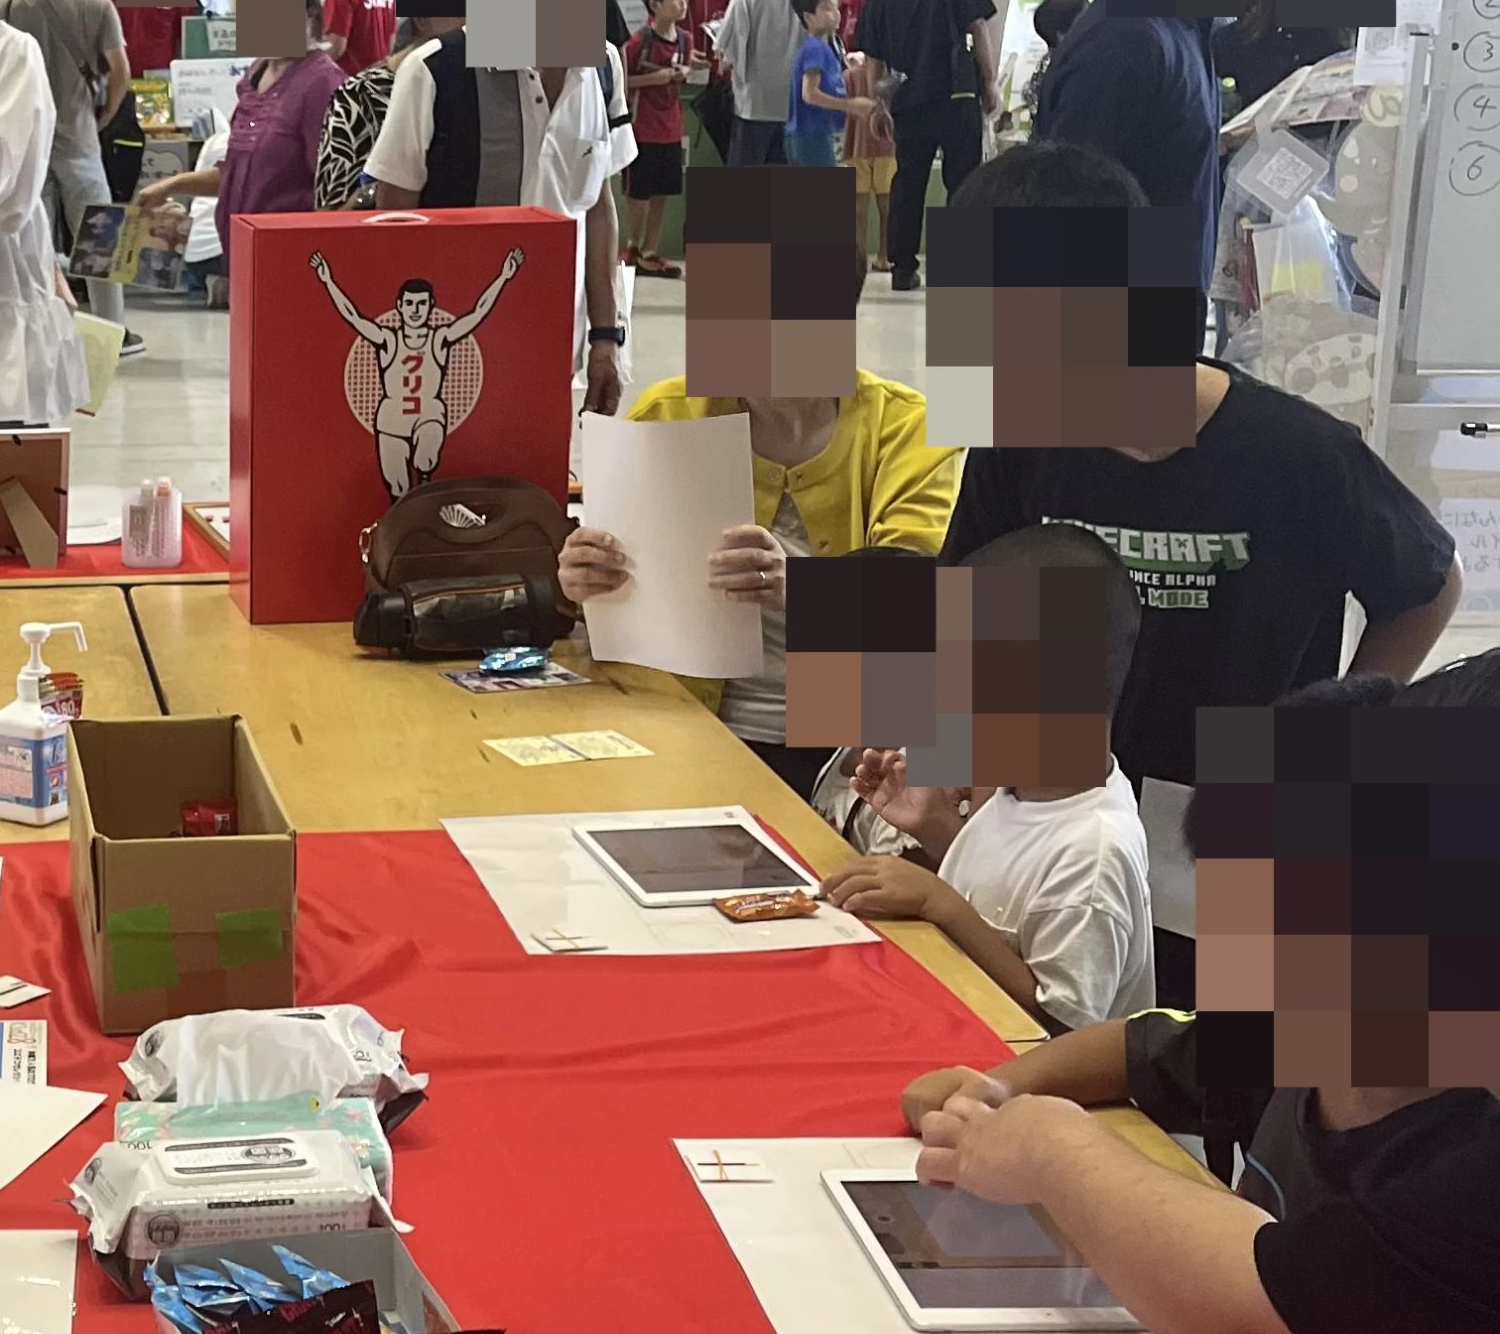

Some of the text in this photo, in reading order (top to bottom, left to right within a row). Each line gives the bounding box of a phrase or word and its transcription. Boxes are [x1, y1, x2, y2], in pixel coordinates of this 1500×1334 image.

[400, 351, 426, 415] グリコ
[1149, 588, 1209, 609] MODE
